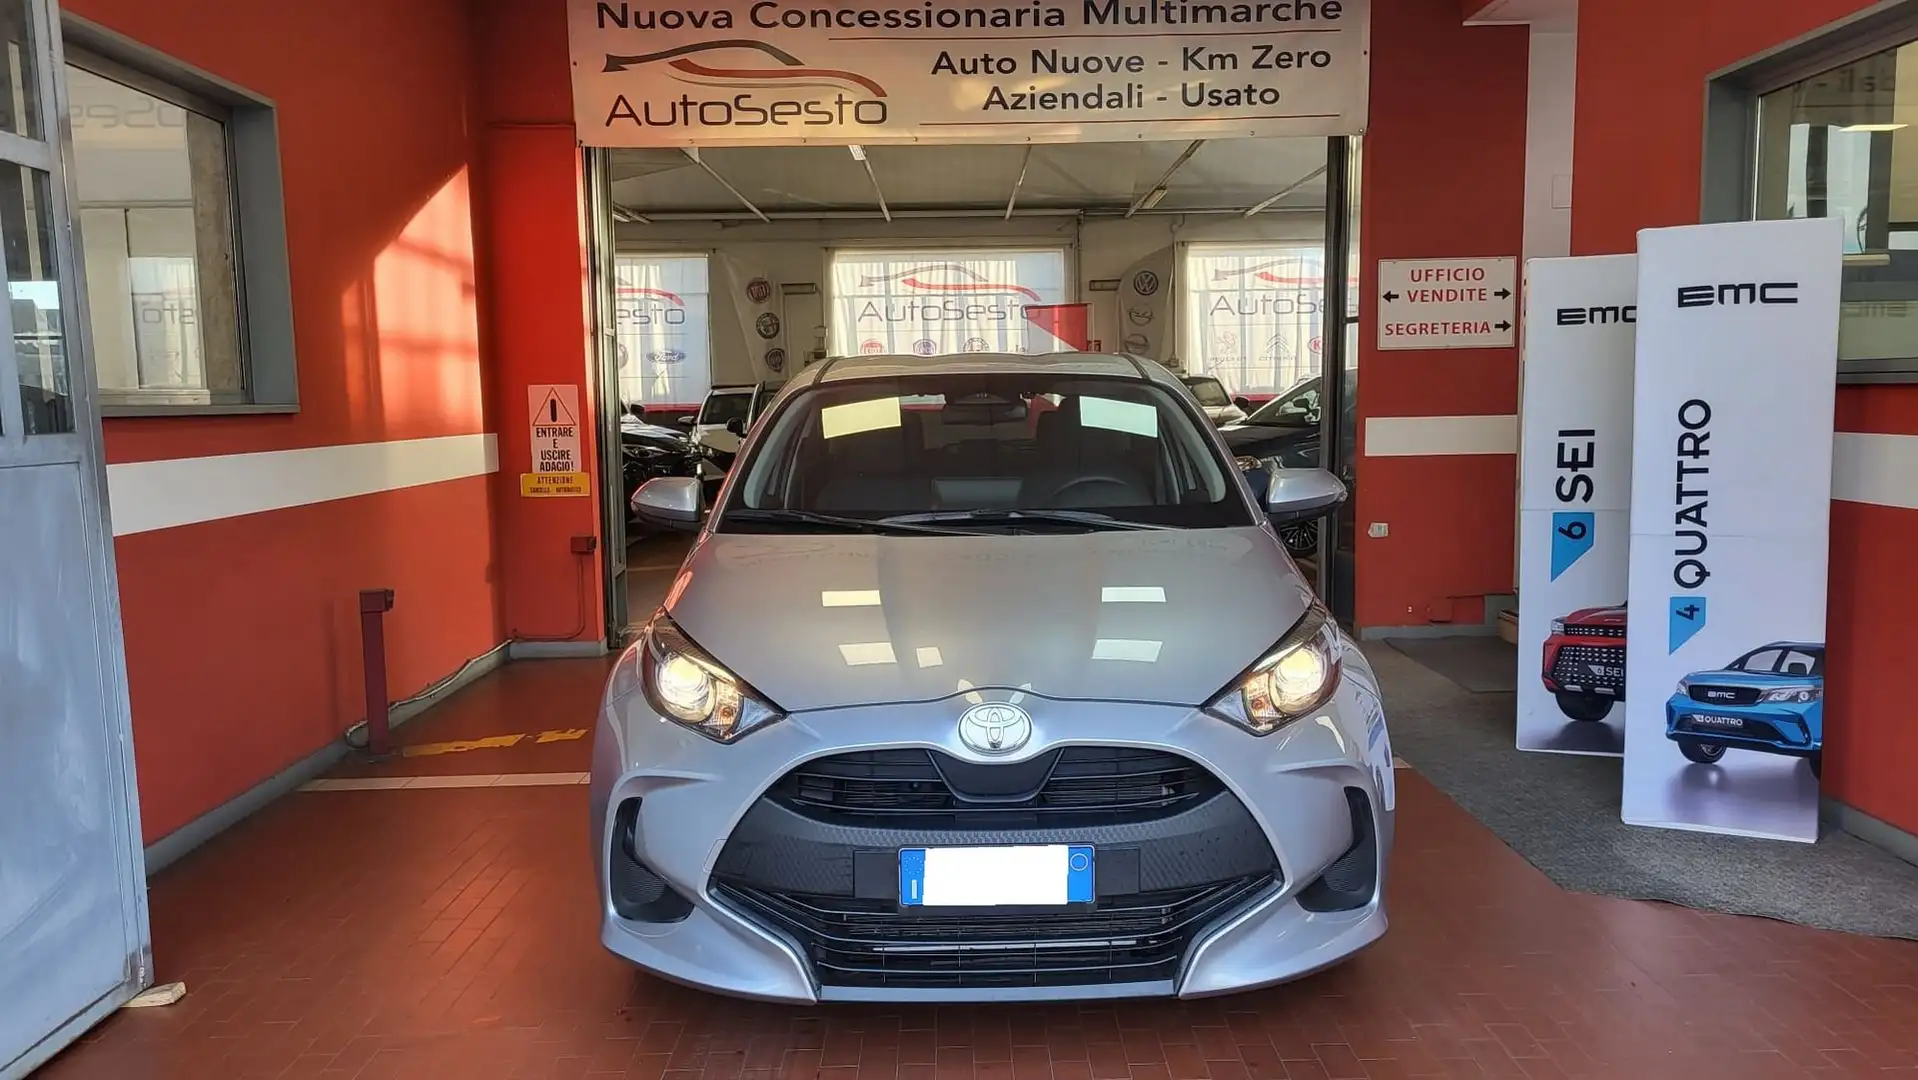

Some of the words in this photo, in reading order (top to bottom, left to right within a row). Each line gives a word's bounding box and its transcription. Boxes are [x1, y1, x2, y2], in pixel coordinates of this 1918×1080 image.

[596, 1, 733, 30] Nuova
[749, 0, 1065, 29] Concessionaria
[1083, 0, 1342, 25] Multimarche
[931, 50, 1017, 76] Auto
[1031, 49, 1145, 74] Nuove
[1182, 47, 1238, 72] Km
[1251, 44, 1332, 70] Zero
[982, 83, 1144, 111] Aziendali
[1181, 82, 1281, 108] Usato
[605, 93, 889, 127] AutoSesto
[1410, 267, 1485, 282] UFFICIO
[1406, 288, 1488, 303] VENDITE
[1677, 282, 1799, 309] EMC
[1384, 321, 1492, 336] SEGRETERIA
[535, 426, 575, 438] ENTRARE
[552, 438, 559, 449] E
[540, 449, 572, 461] USCIRE
[539, 461, 575, 472] ADAGIO!
[1555, 429, 1596, 504] SEI
[1673, 398, 1712, 589] QUATTRO
[1675, 604, 1700, 621] 4
[1704, 715, 1743, 726] QUATTRO
